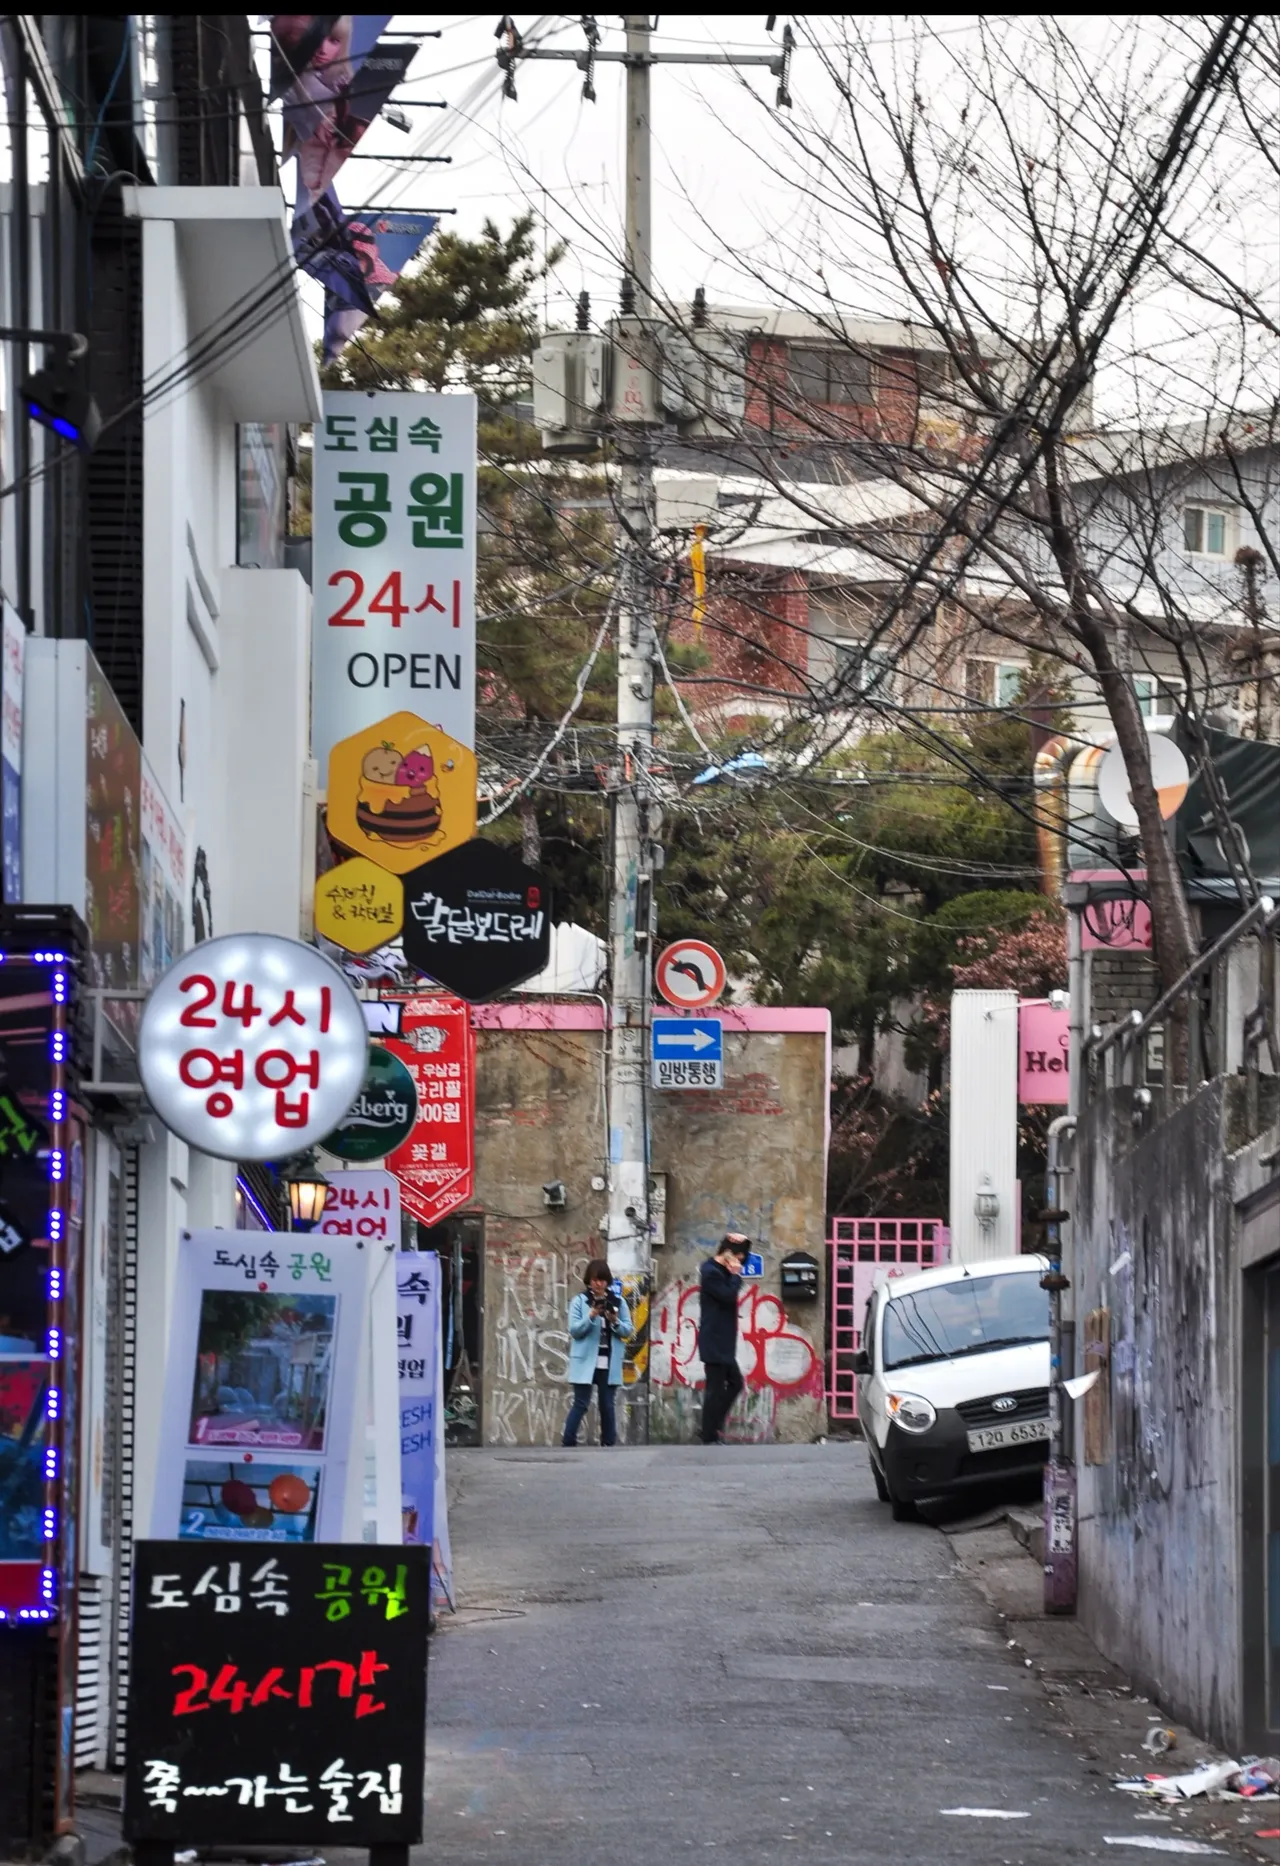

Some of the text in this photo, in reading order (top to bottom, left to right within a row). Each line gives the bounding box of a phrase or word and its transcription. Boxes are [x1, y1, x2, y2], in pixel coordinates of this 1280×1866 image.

[324, 415, 443, 454] 도심속
[334, 471, 464, 549] 공원
[327, 569, 461, 628] 24시
[347, 652, 461, 690] OPEN
[333, 905, 346, 920] &
[410, 893, 544, 944] 달달보드레
[179, 974, 331, 1033] 24시
[179, 1048, 320, 1128] 영업
[659, 1061, 717, 1085] 일방통행
[347, 1093, 409, 1123] sberg
[322, 1186, 390, 1211] 24시
[213, 1249, 332, 1282] 도심속 공원
[401, 1403, 432, 1428] ESH
[401, 1430, 432, 1455] ESH
[146, 1558, 409, 1622] 도심속 공원
[171, 1650, 390, 1719] 24시간
